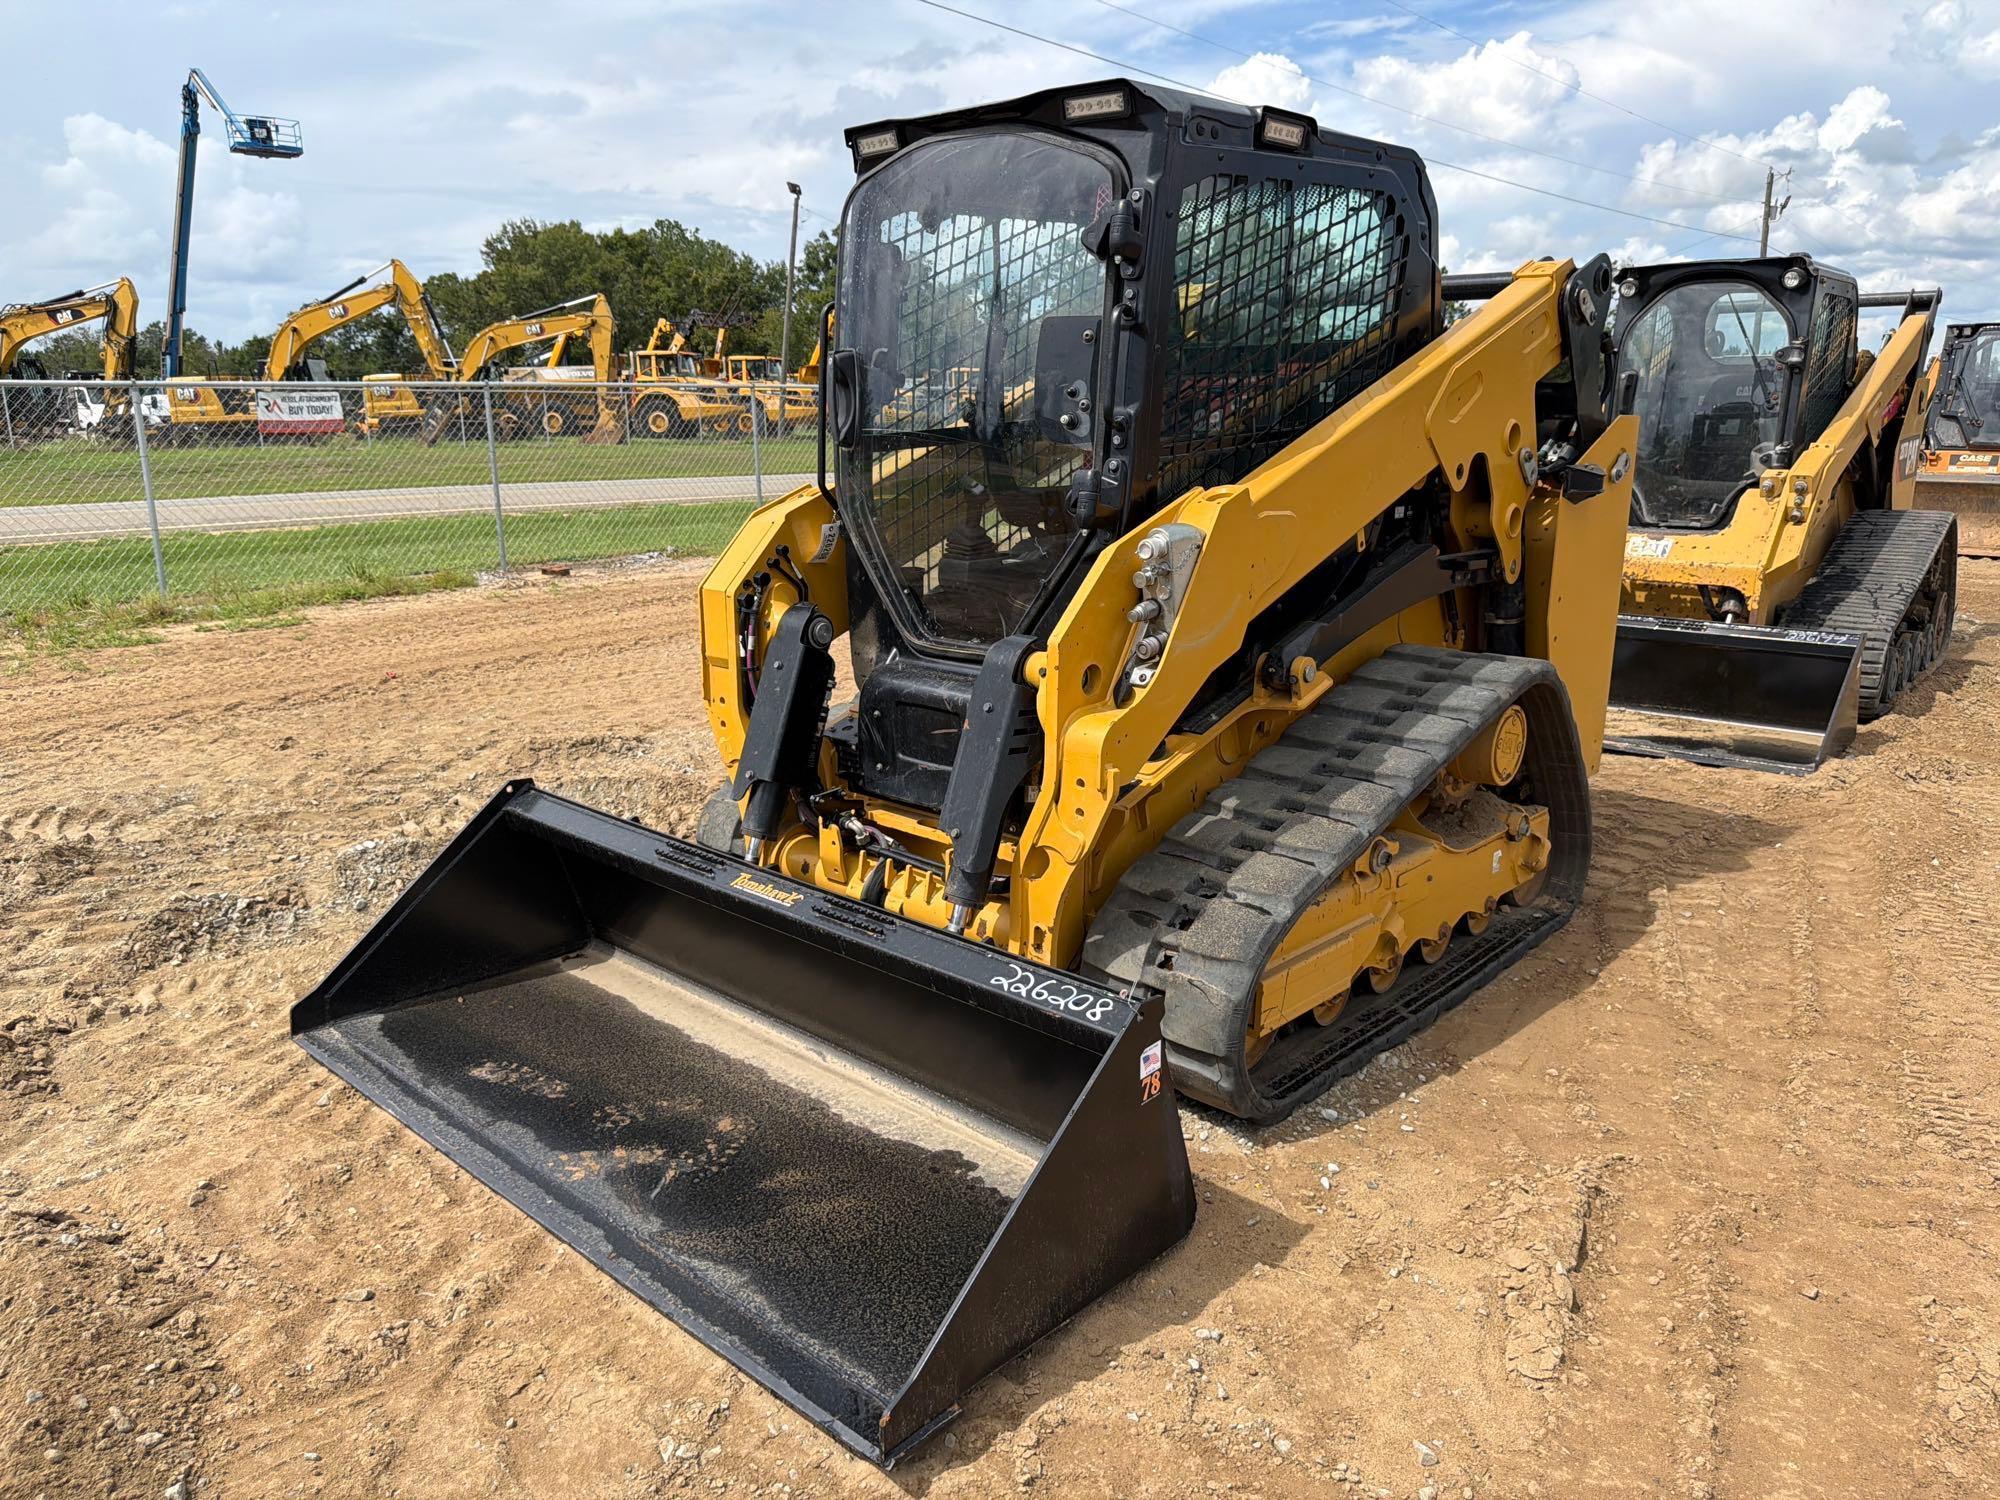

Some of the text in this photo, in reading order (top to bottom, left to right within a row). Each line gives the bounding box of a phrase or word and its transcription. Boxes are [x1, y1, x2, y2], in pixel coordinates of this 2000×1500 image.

[56, 309, 74, 324] CAT
[329, 304, 345, 319] CAT
[525, 323, 541, 336] CAT
[176, 387, 196, 401] CAT
[288, 405, 334, 415] BUY TODAY!
[1958, 454, 1993, 463] CASE
[730, 872, 805, 905] Tomahawk
[990, 963, 1114, 1021] 226208
[1141, 1071, 1161, 1101] 78
